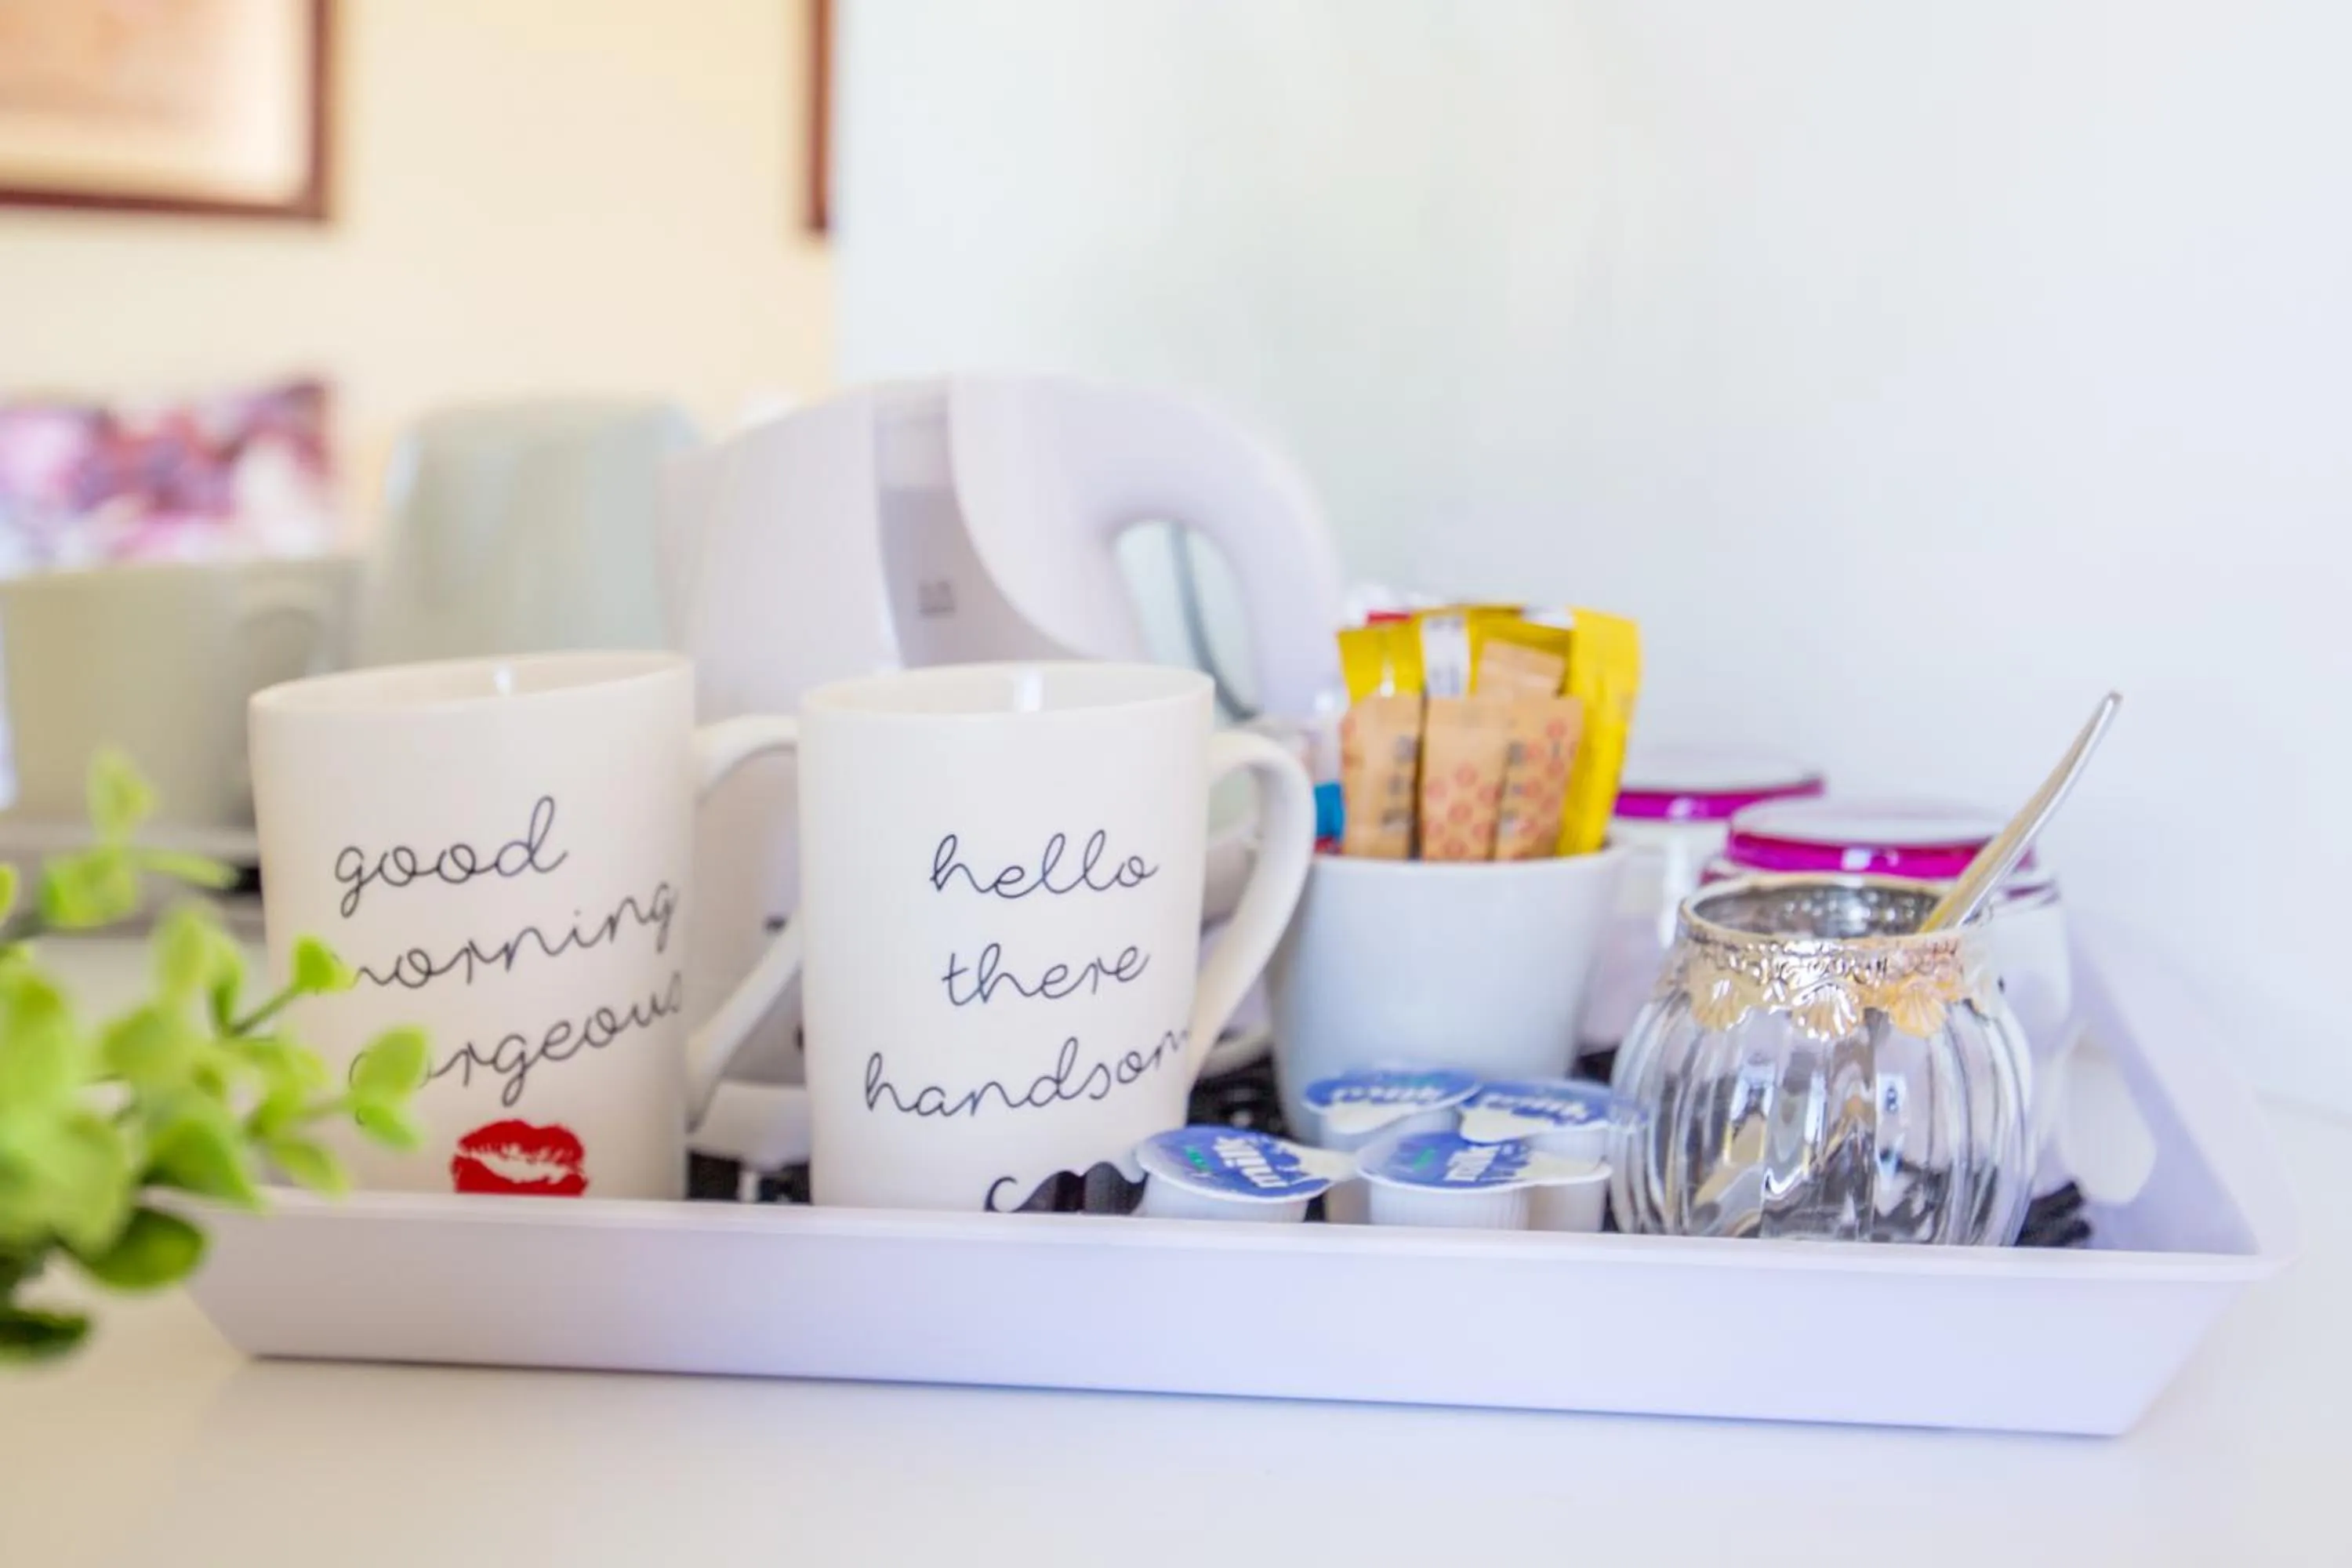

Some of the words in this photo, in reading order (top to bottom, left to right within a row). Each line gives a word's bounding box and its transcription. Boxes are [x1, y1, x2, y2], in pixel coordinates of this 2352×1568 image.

[334, 795, 568, 918] good
[930, 829, 1159, 899] hello
[941, 942, 1150, 1007] there
[864, 1029, 1190, 1117] handsom
